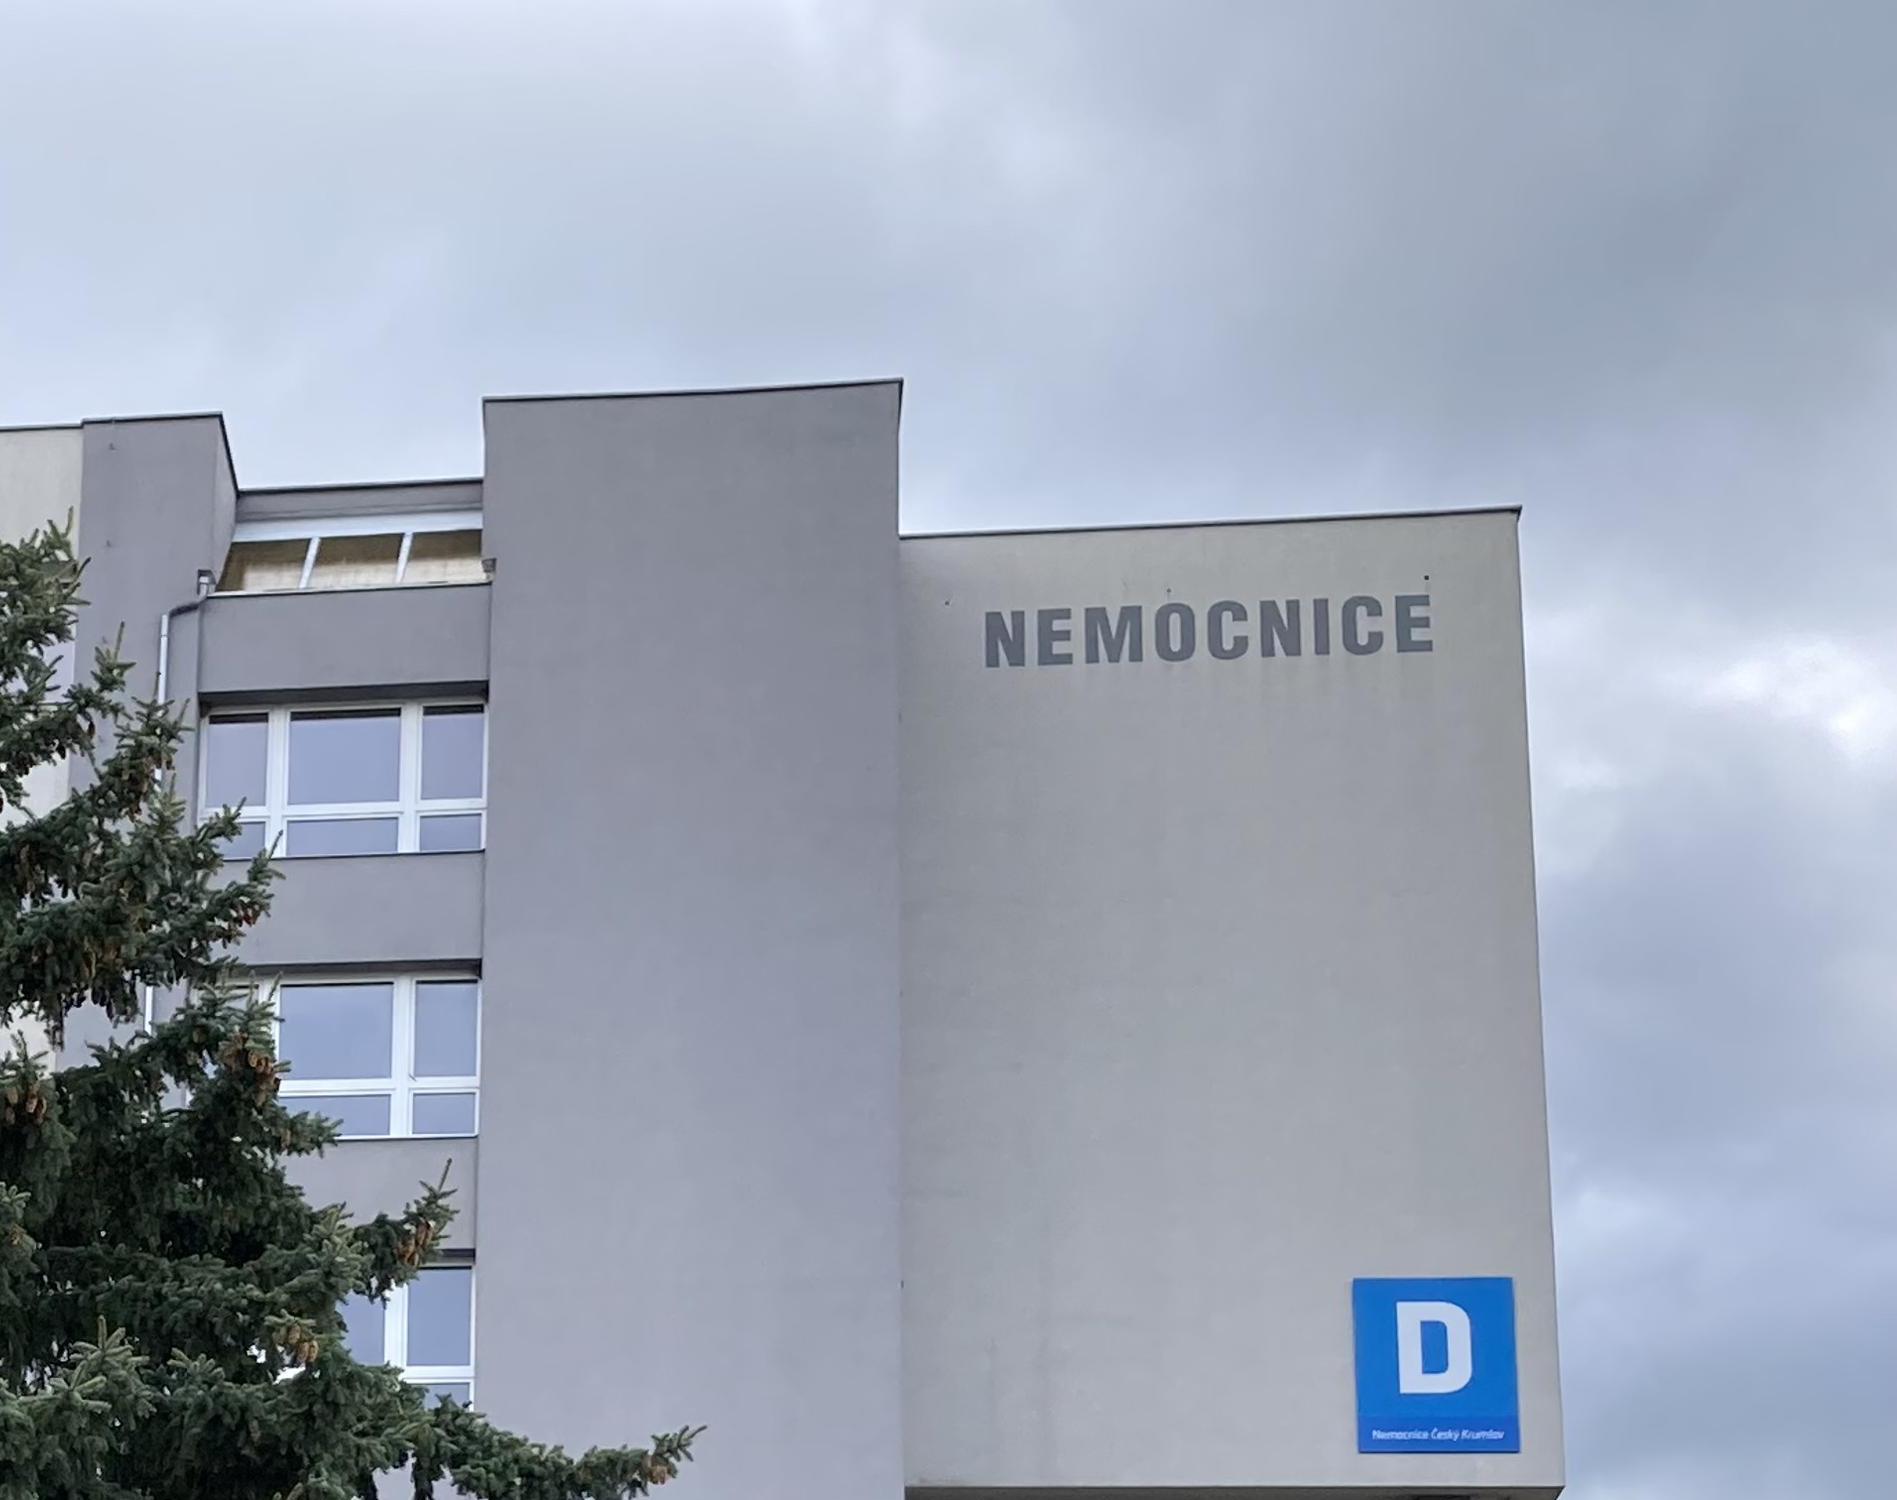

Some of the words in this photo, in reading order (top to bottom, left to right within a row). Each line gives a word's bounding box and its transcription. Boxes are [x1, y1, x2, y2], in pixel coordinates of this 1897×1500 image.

[985, 594, 1433, 668] NEMOCNICE
[1396, 1301, 1473, 1394] D
[1372, 1430, 1429, 1440] Nemocnice
[1431, 1427, 1460, 1441] Český
[1461, 1429, 1504, 1440] Krumlov
